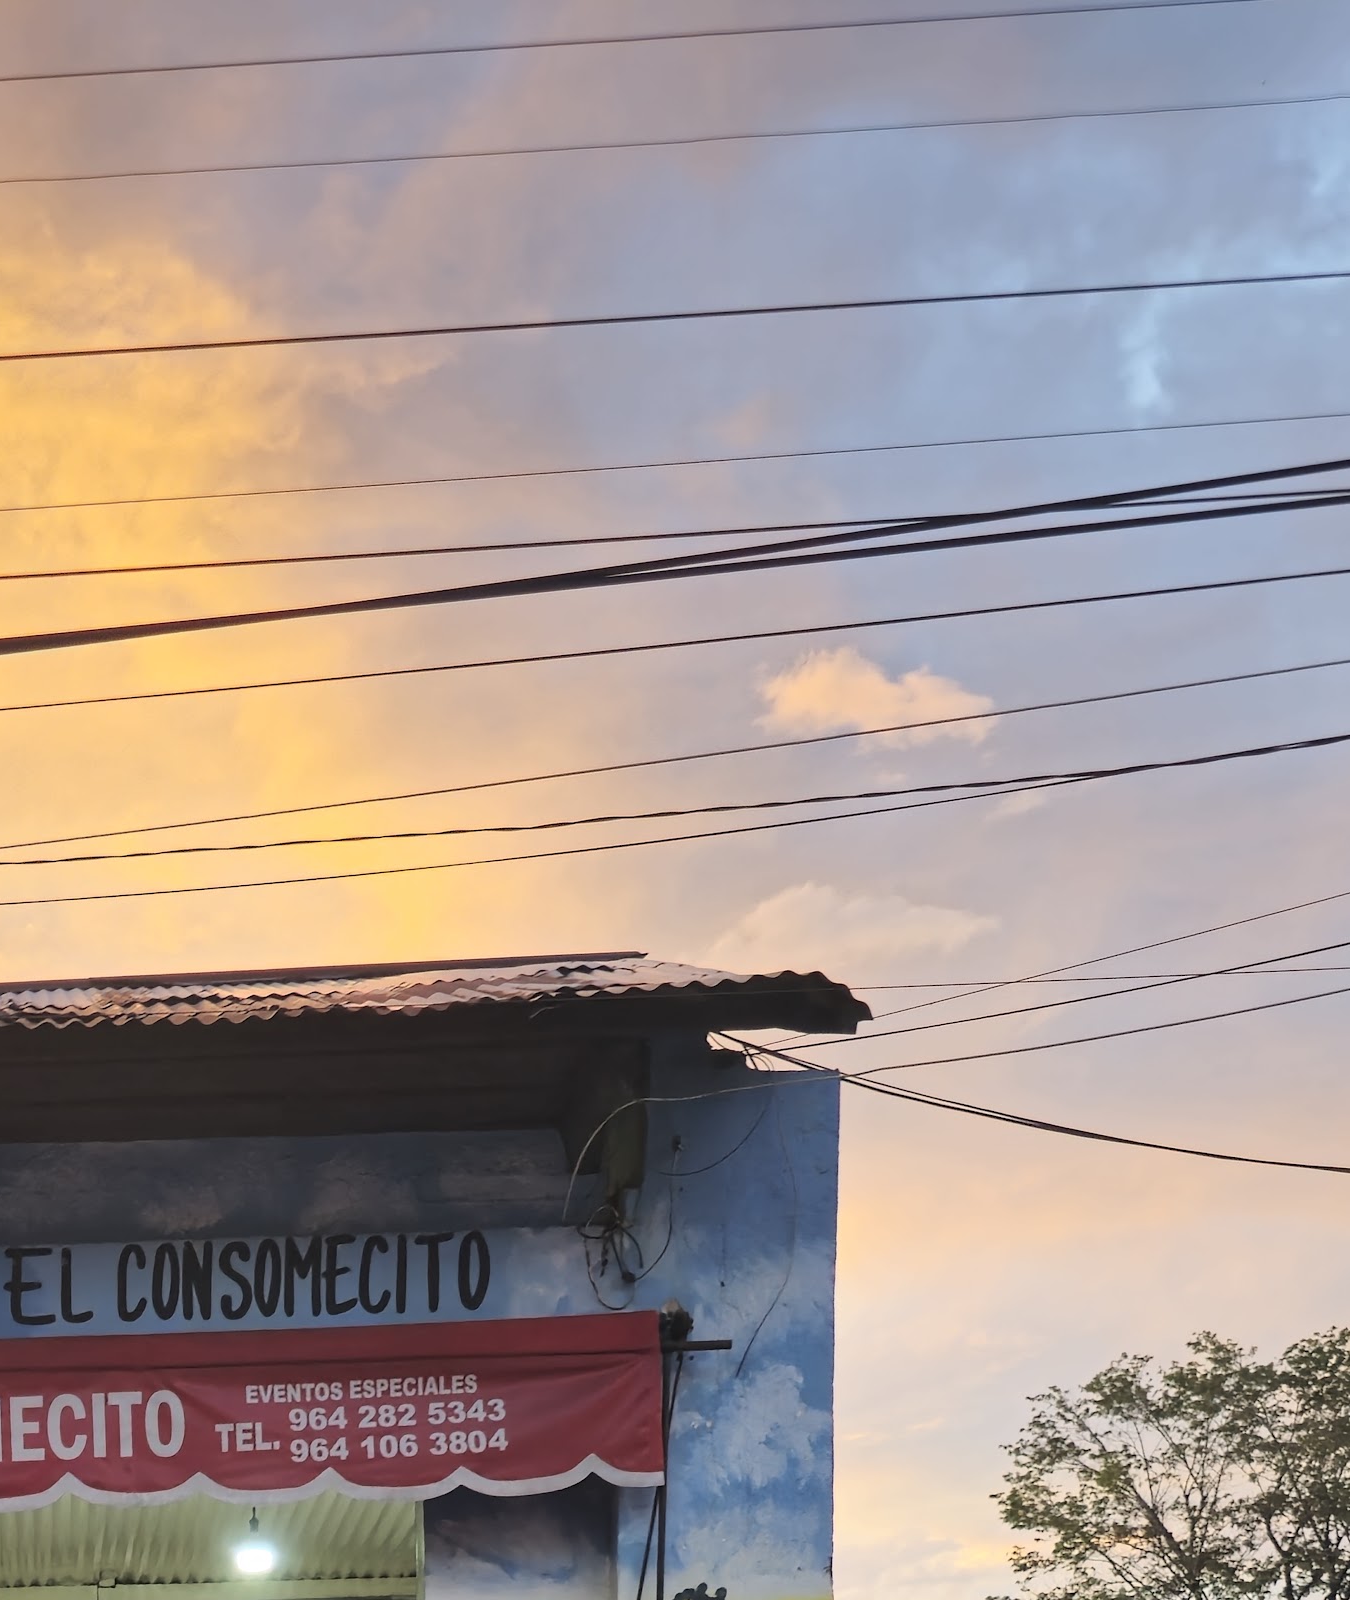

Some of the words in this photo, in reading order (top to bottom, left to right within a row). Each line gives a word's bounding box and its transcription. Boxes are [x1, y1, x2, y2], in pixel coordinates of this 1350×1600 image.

[3, 1247, 95, 1326] EL
[117, 1230, 491, 1322] CONSOMECITO
[245, 1382, 343, 1404] EVENTOS
[349, 1374, 478, 1400] ESPECIALES
[288, 1406, 348, 1432] 964
[357, 1403, 417, 1429] 282
[427, 1398, 507, 1425] 5343
[214, 1422, 281, 1453] TEL.
[290, 1437, 349, 1463] 964
[360, 1434, 419, 1460] 106
[429, 1428, 509, 1455] 3804
